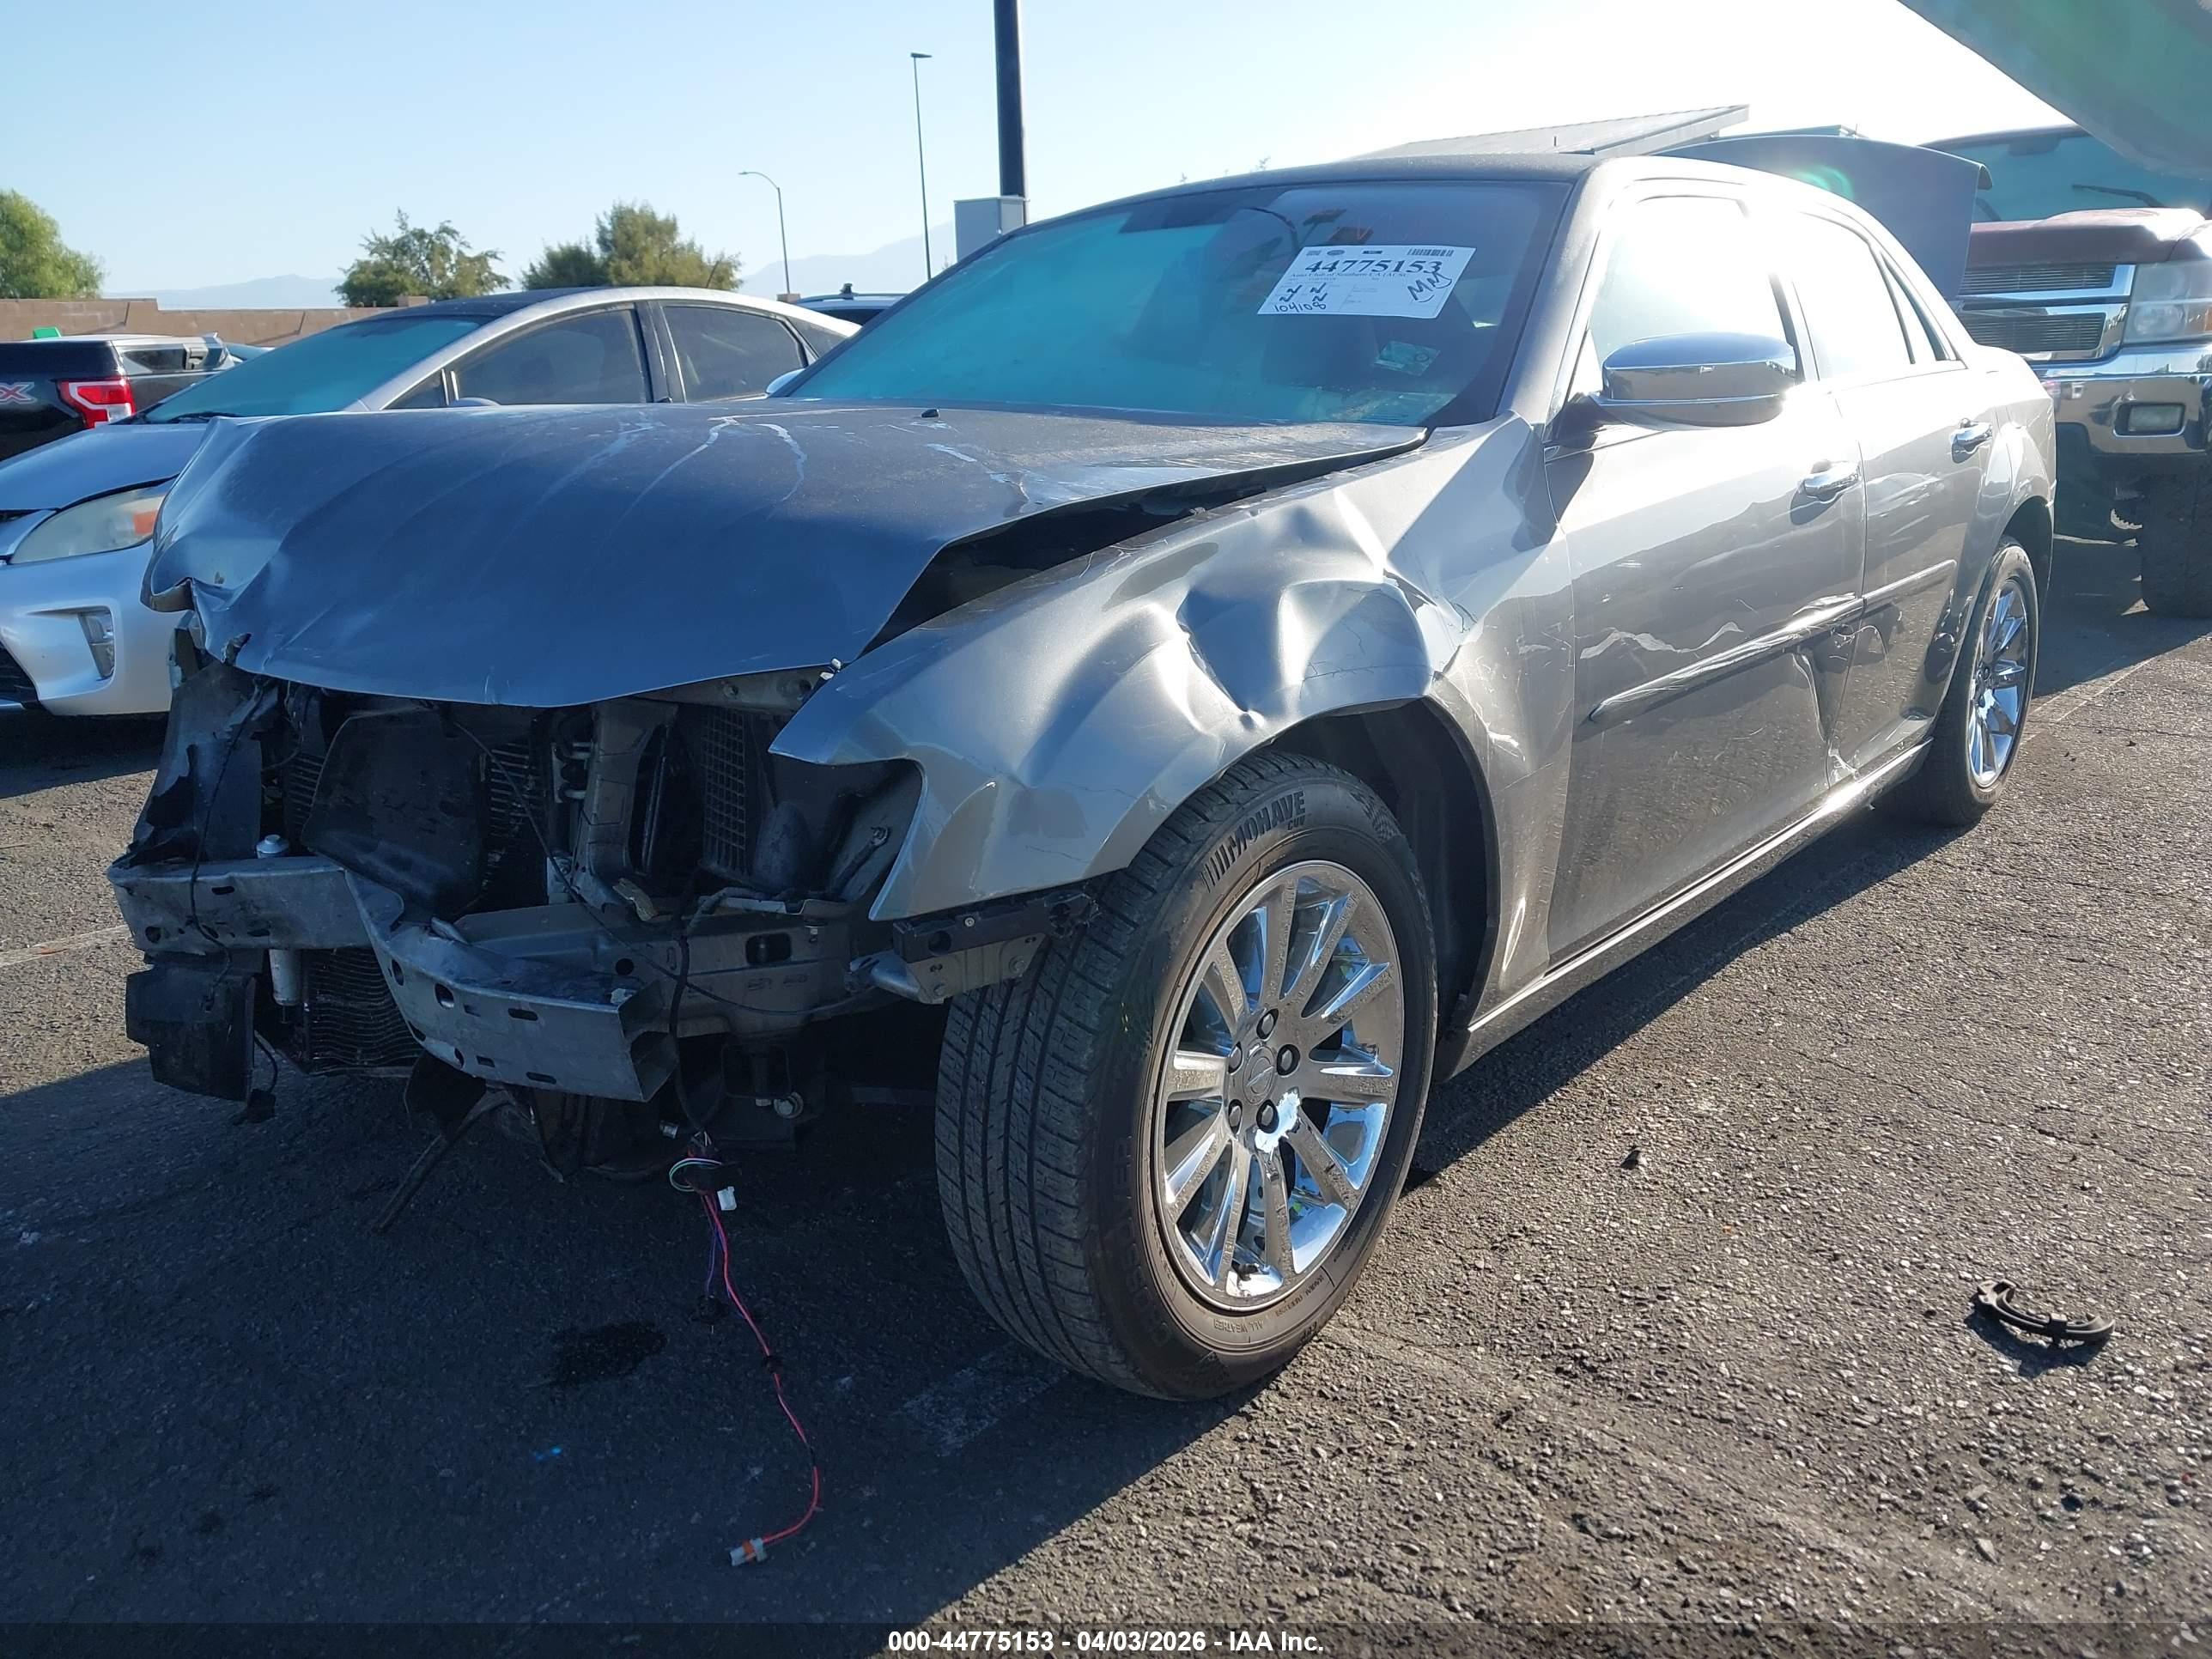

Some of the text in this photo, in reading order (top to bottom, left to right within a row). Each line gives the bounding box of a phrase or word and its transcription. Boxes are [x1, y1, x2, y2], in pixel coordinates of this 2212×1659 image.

[1305, 259, 1443, 275] 44775153
[1274, 301, 1327, 313] 104108
[1228, 790, 1306, 863] MOHAVE
[1288, 815, 1306, 831] CUV
